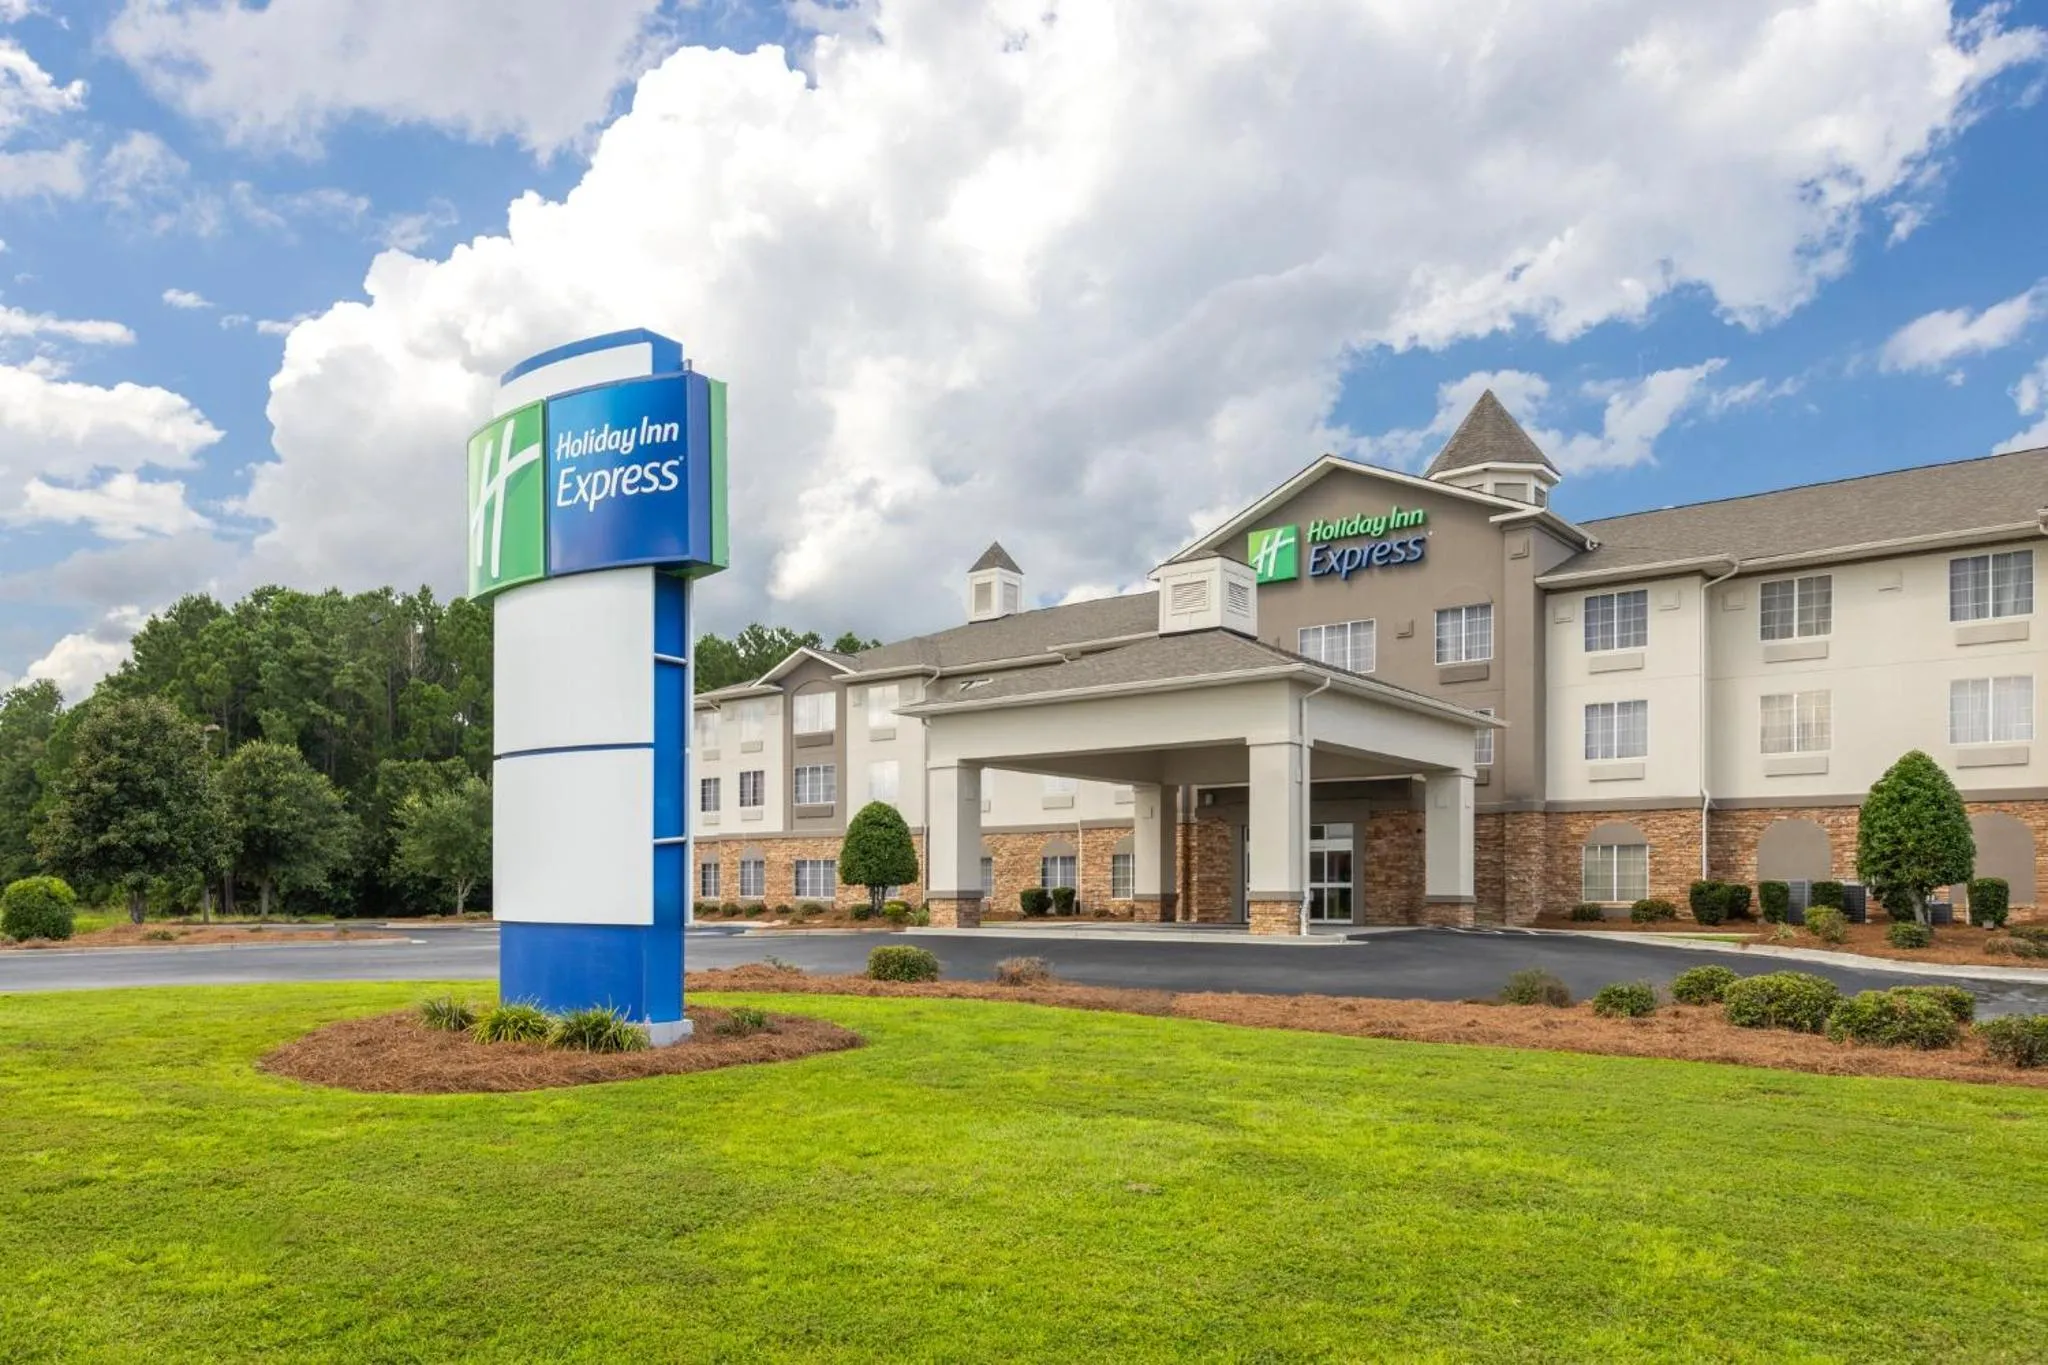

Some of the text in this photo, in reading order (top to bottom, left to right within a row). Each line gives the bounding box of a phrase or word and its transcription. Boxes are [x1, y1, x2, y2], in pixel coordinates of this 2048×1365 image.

[556, 416, 679, 461] Holiday Inn
[556, 460, 680, 512] Express
[1307, 506, 1425, 543] Holiday Inn
[1308, 536, 1426, 580] Express
